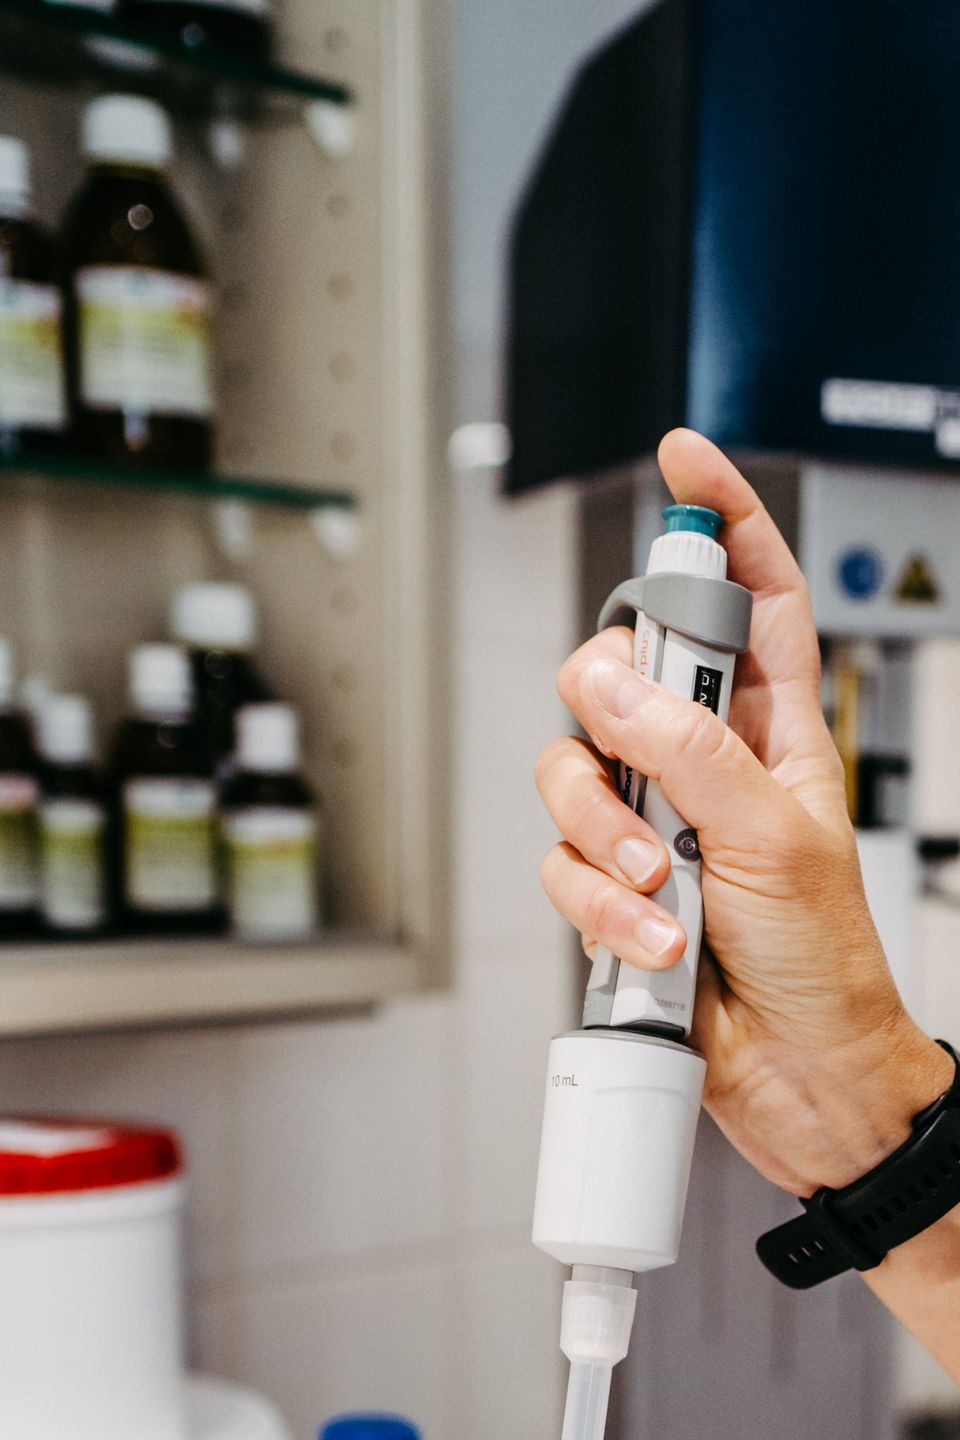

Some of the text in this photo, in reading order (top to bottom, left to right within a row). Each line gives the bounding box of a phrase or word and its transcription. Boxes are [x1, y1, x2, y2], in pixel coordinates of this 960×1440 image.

[640, 630, 649, 666] plus
[551, 1073, 578, 1087] 10 mL
